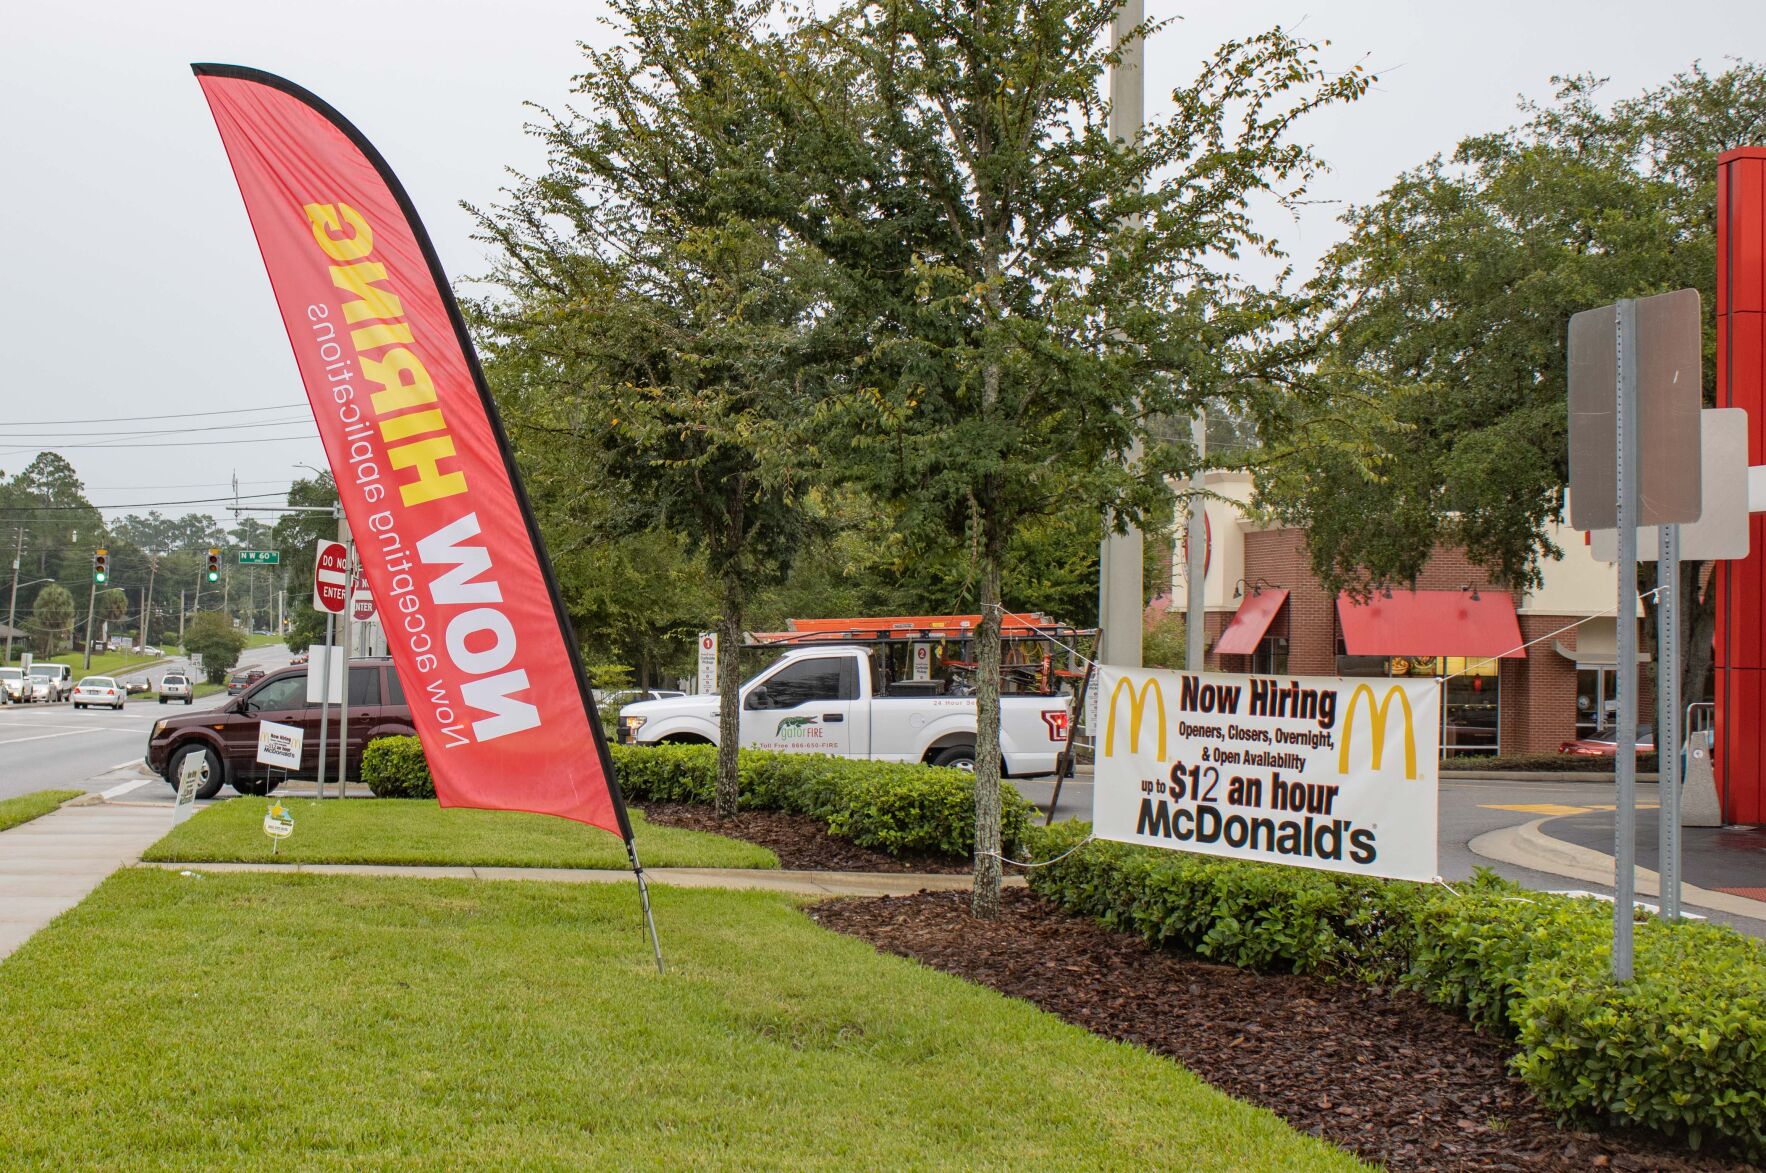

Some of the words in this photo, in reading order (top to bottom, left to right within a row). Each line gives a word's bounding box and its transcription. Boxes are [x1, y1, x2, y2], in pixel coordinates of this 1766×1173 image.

[259, 552, 270, 560] 60
[322, 555, 333, 567] DO
[337, 557, 347, 570] NO
[323, 586, 346, 600] ENTER
[354, 602, 373, 611] NTER
[1180, 675, 1241, 715] Now
[1249, 677, 1337, 729] Hiring
[1179, 721, 1225, 742] Openers,
[1227, 724, 1272, 746] Closers,
[1275, 727, 1334, 751] Overnight,
[1201, 746, 1211, 762] &
[1213, 747, 1240, 766] Open
[1141, 779, 1154, 794] up
[1156, 778, 1166, 794] to
[1169, 760, 1220, 804] $12
[1227, 775, 1262, 808] an
[1270, 771, 1339, 816] hour
[1136, 797, 1377, 865] McDonald's
